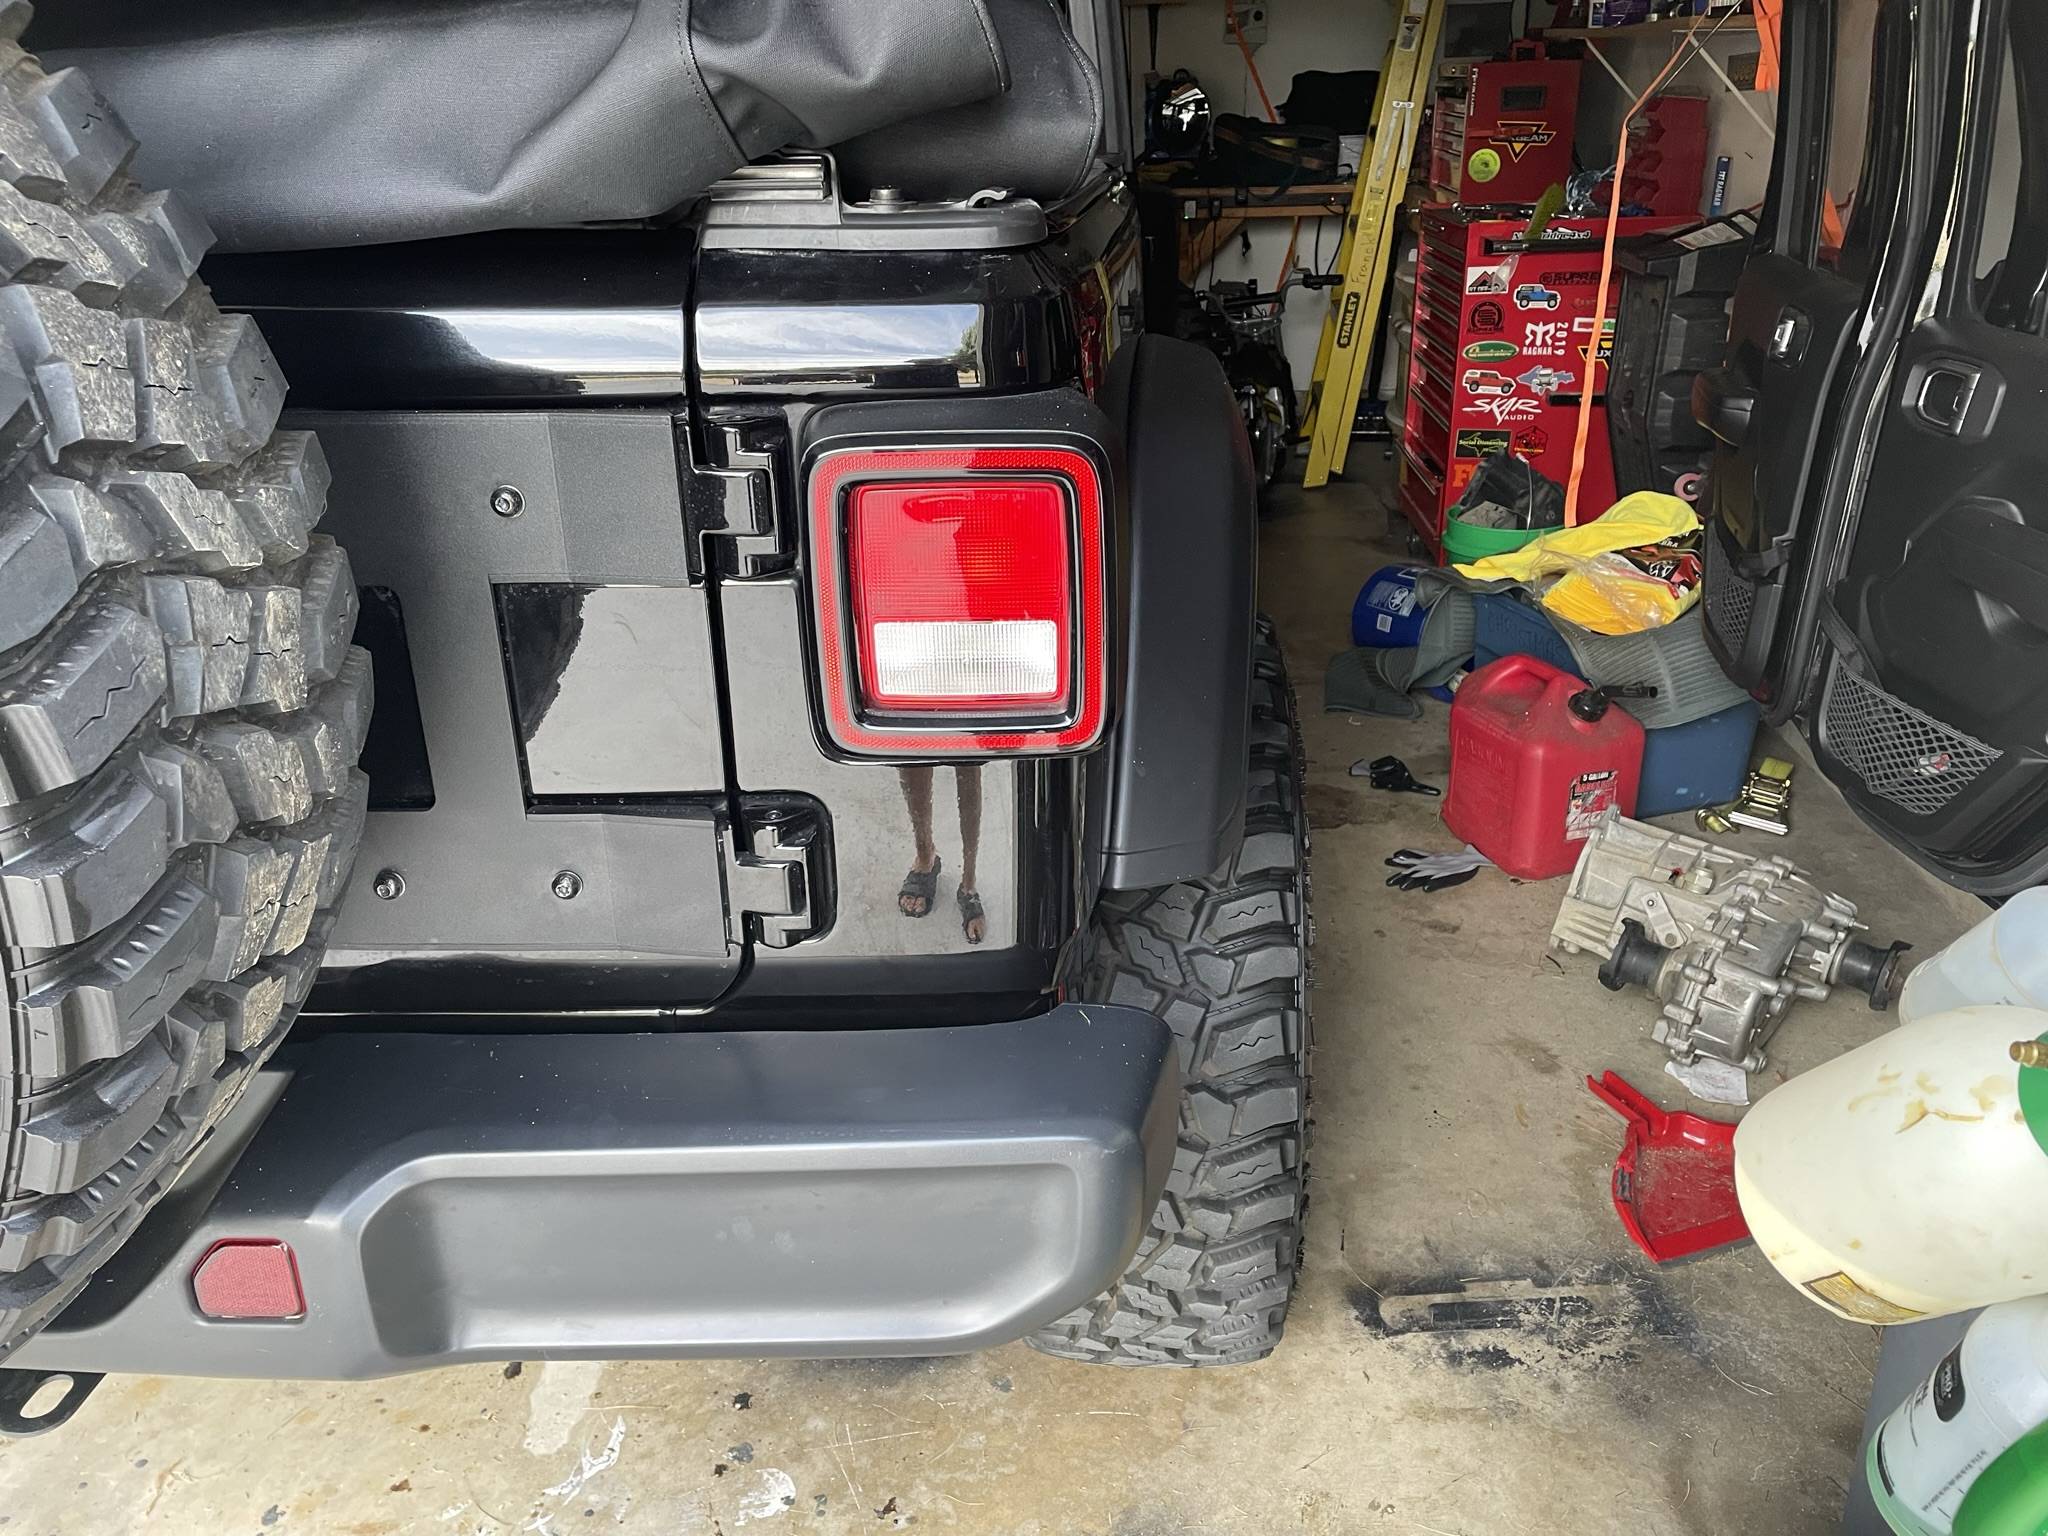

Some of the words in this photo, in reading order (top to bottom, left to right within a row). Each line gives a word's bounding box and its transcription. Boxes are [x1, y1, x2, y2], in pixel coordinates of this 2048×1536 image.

[1339, 294, 1359, 345] STANLEY
[1522, 347, 1552, 356] RAGNAR
[1556, 321, 1569, 356] 2019
[1462, 397, 1542, 425] SKAR
[1583, 774, 1588, 782] 5
